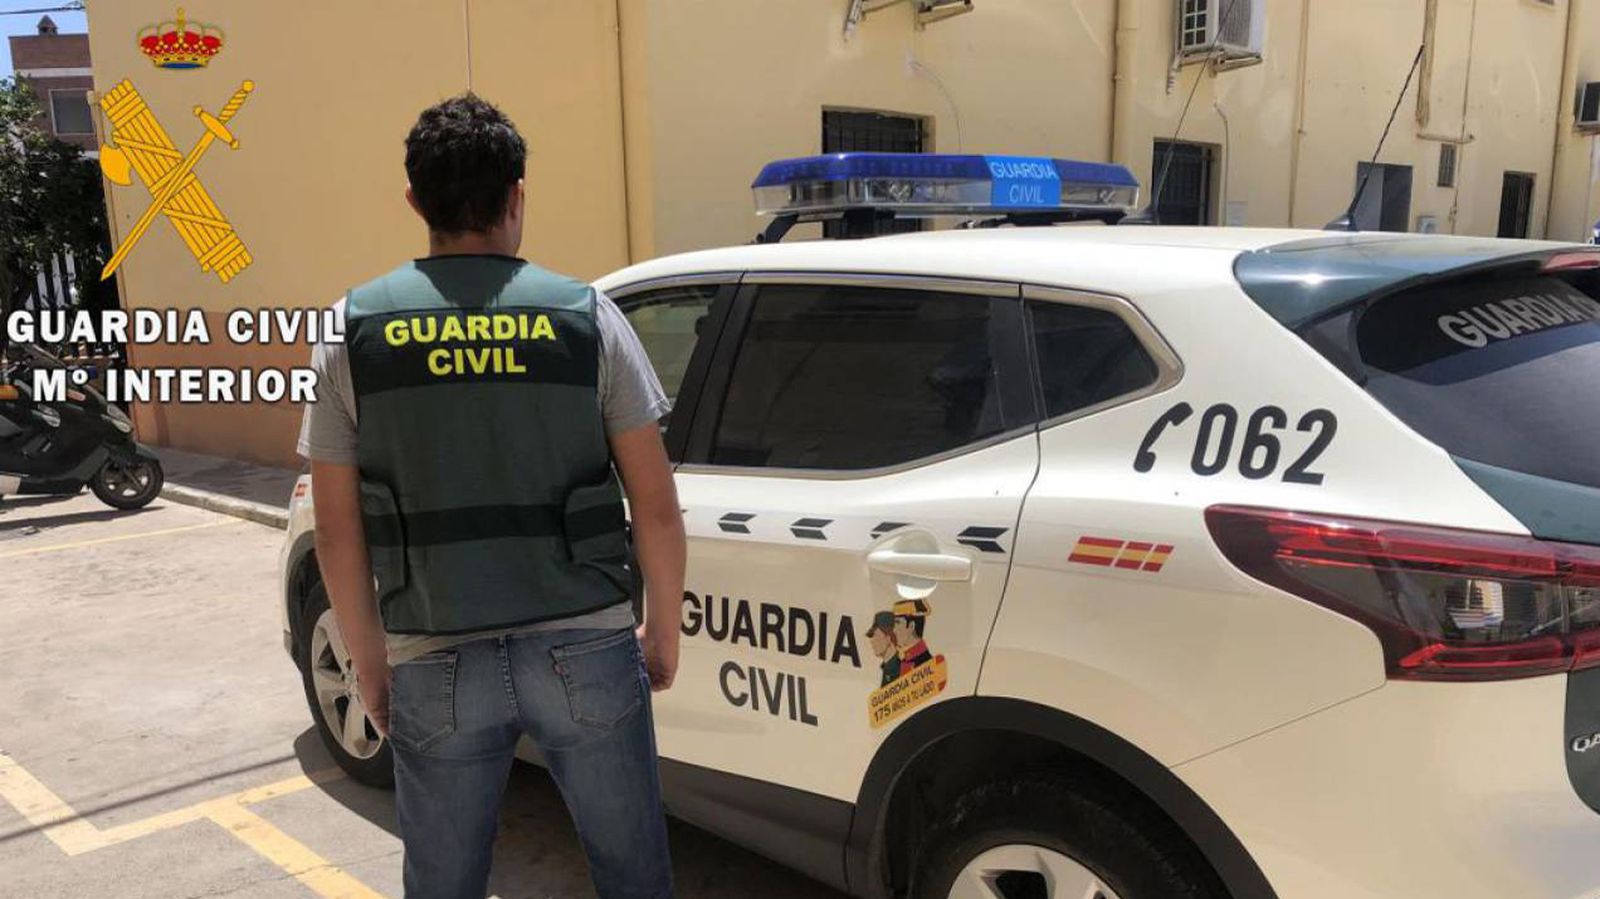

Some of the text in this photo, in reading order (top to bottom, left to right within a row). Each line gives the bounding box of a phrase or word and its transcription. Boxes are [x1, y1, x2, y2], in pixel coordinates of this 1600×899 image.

[990, 161, 1060, 180] GUARDIA
[1008, 184, 1045, 204] CIVIL
[384, 313, 557, 347] GUARDIA
[1437, 294, 1591, 348] GUARDIA
[427, 347, 527, 376] CIVIL
[1190, 402, 1338, 486] 062
[680, 590, 862, 668] GUARDIA
[719, 660, 818, 726] CIVIL
[871, 666, 934, 708] GUARDIA CIVIL
[874, 703, 891, 722] 175
